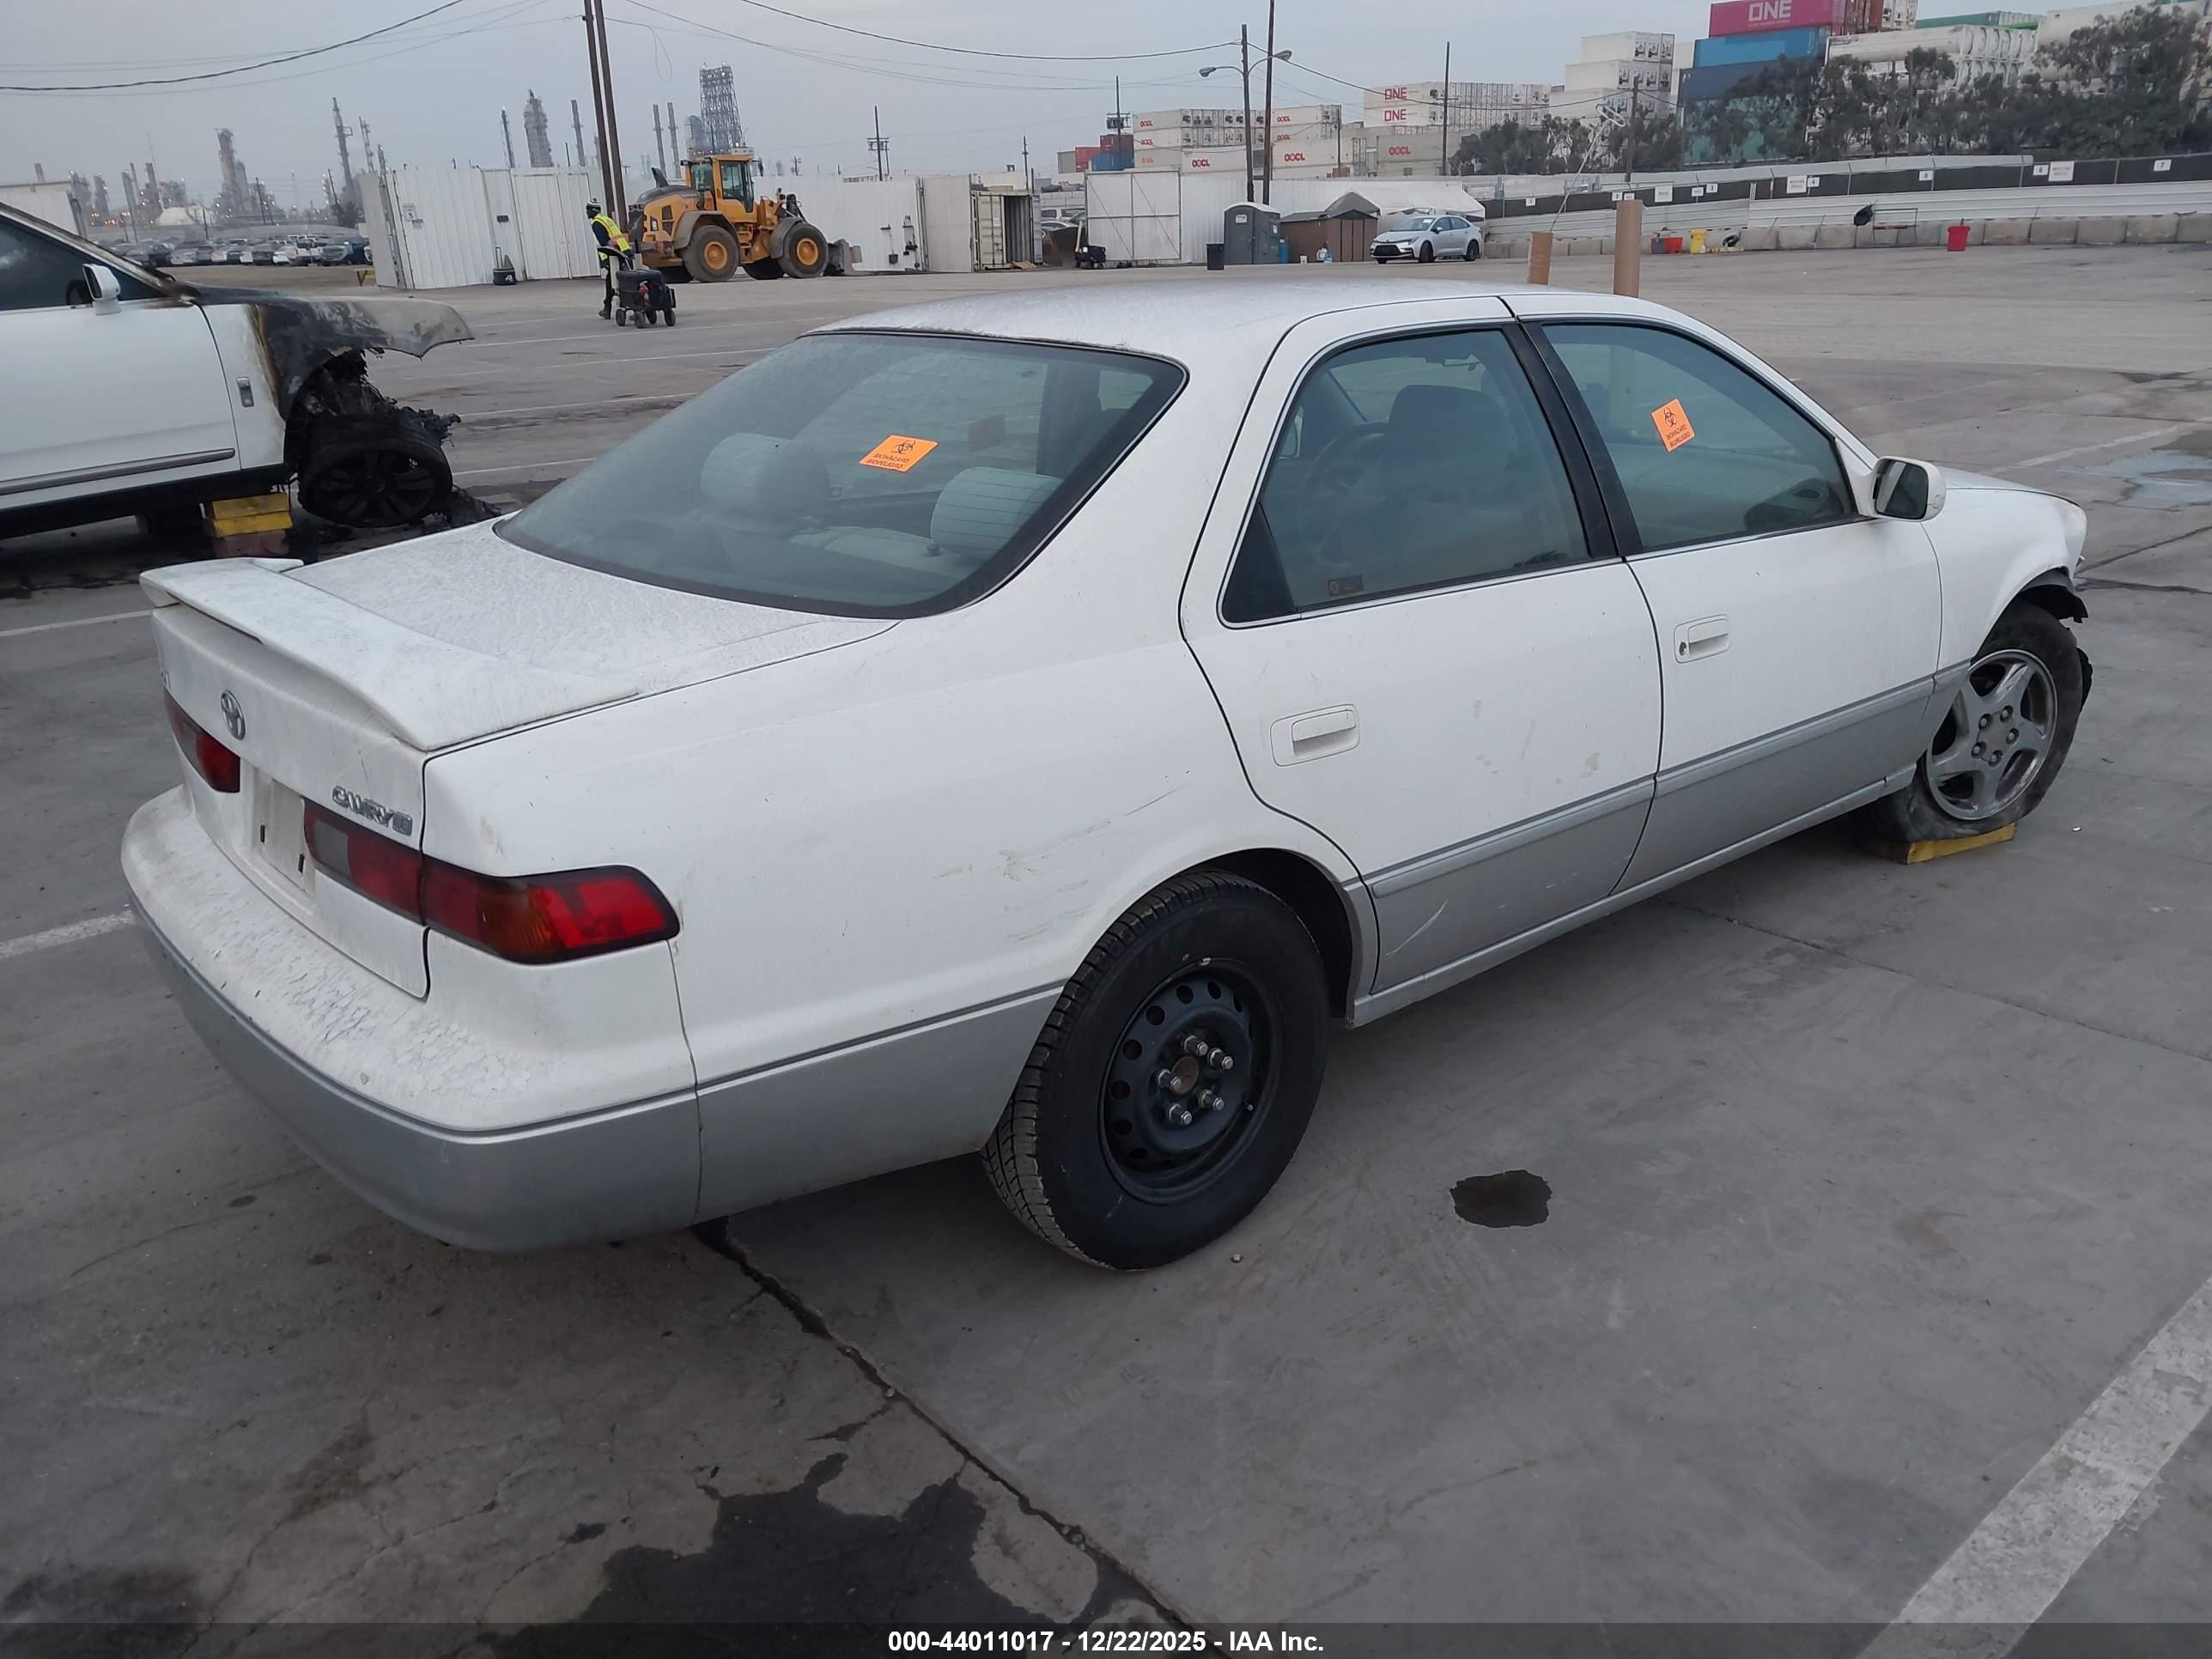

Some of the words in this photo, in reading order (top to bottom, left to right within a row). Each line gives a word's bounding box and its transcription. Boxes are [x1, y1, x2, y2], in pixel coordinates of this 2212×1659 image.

[1748, 0, 1793, 21] ONE
[1384, 88, 1407, 100] ONE
[1384, 109, 1407, 122] ONE
[1192, 158, 1210, 168] OOCL
[1284, 153, 1306, 162] OOCL
